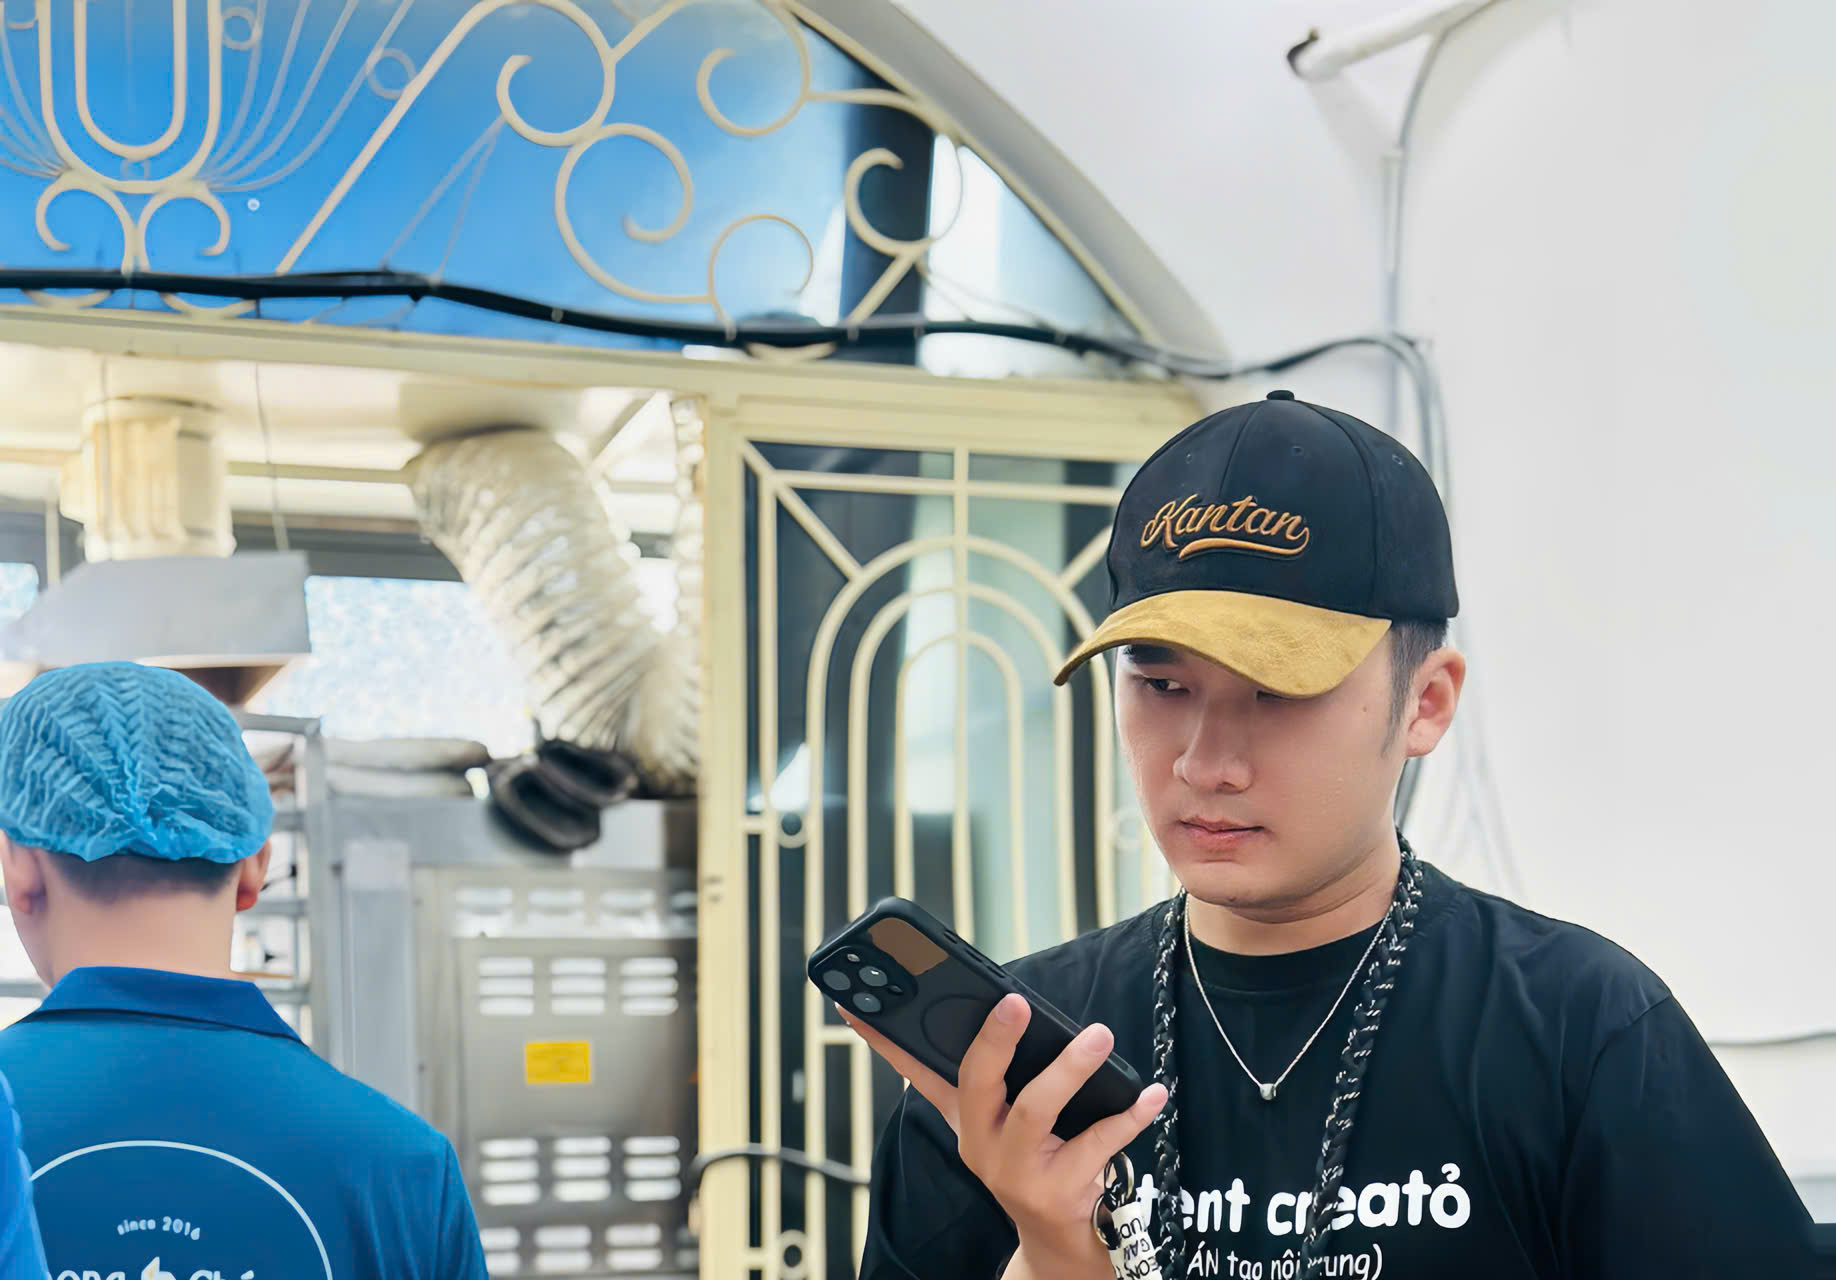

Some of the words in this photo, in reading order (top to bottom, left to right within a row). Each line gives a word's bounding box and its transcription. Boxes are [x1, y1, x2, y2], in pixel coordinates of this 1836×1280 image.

[1140, 493, 1310, 556] Kantan
[1136, 1173, 1250, 1233] tent
[117, 1218, 156, 1236] since
[162, 1216, 201, 1240] 2016
[1187, 1240, 1219, 1277] ÁN
